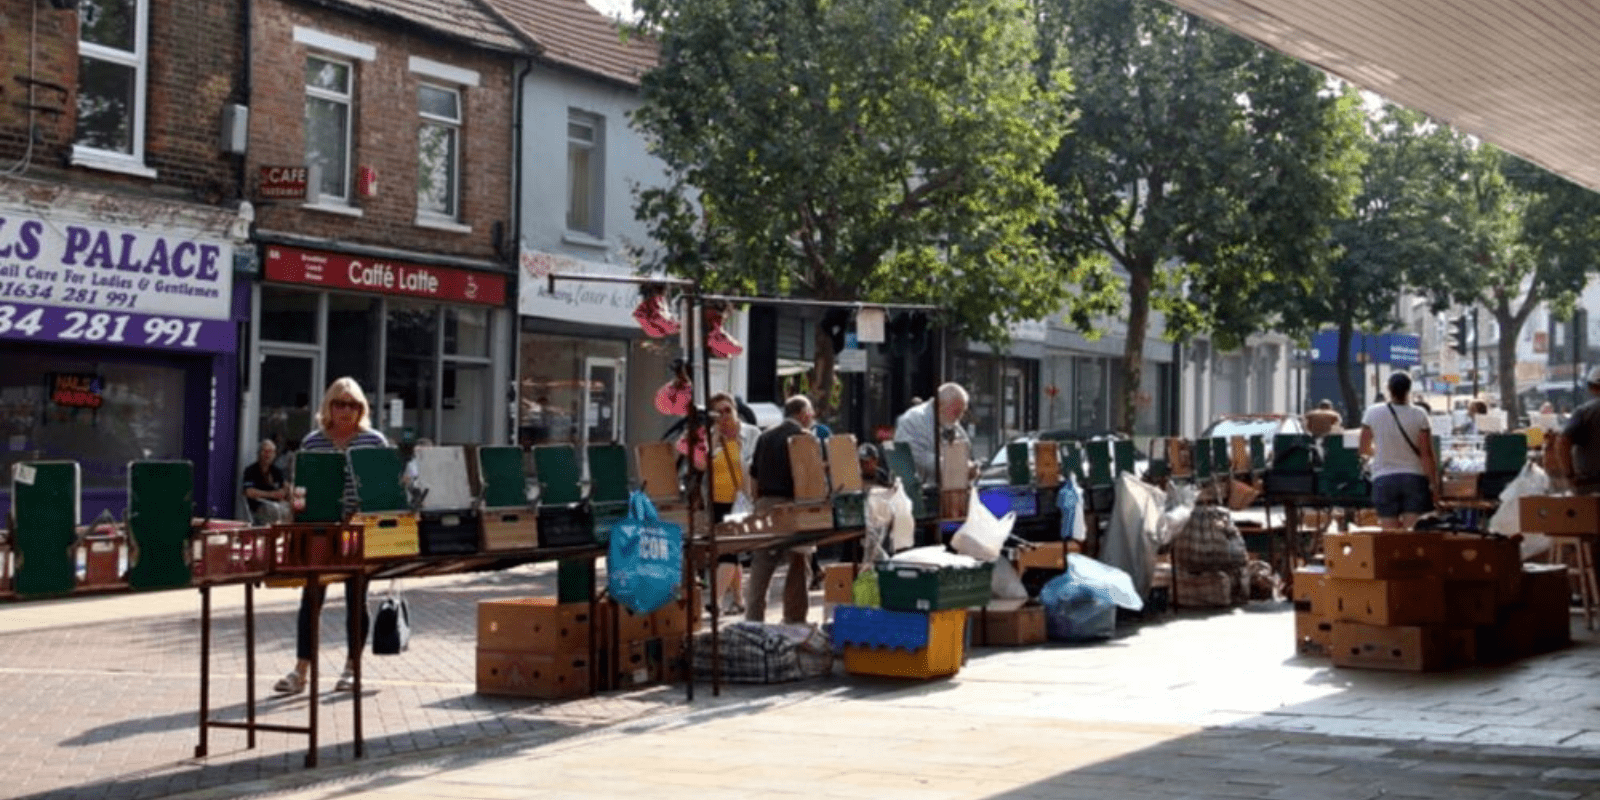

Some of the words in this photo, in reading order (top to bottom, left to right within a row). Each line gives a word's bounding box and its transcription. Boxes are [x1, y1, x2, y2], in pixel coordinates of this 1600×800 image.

[268, 167, 306, 184] CAFE
[61, 225, 219, 282] PALACE
[0, 263, 19, 278] ail
[26, 265, 58, 283] Care
[64, 269, 86, 285] For
[91, 272, 132, 290] Ladies
[138, 277, 151, 291] &
[155, 279, 219, 298] Gentlemen
[348, 260, 395, 290] Caffé
[398, 266, 440, 294] Latte
[61, 286, 98, 304] 281
[106, 291, 139, 309] 991
[58, 310, 131, 342] 281
[143, 317, 203, 347] 991
